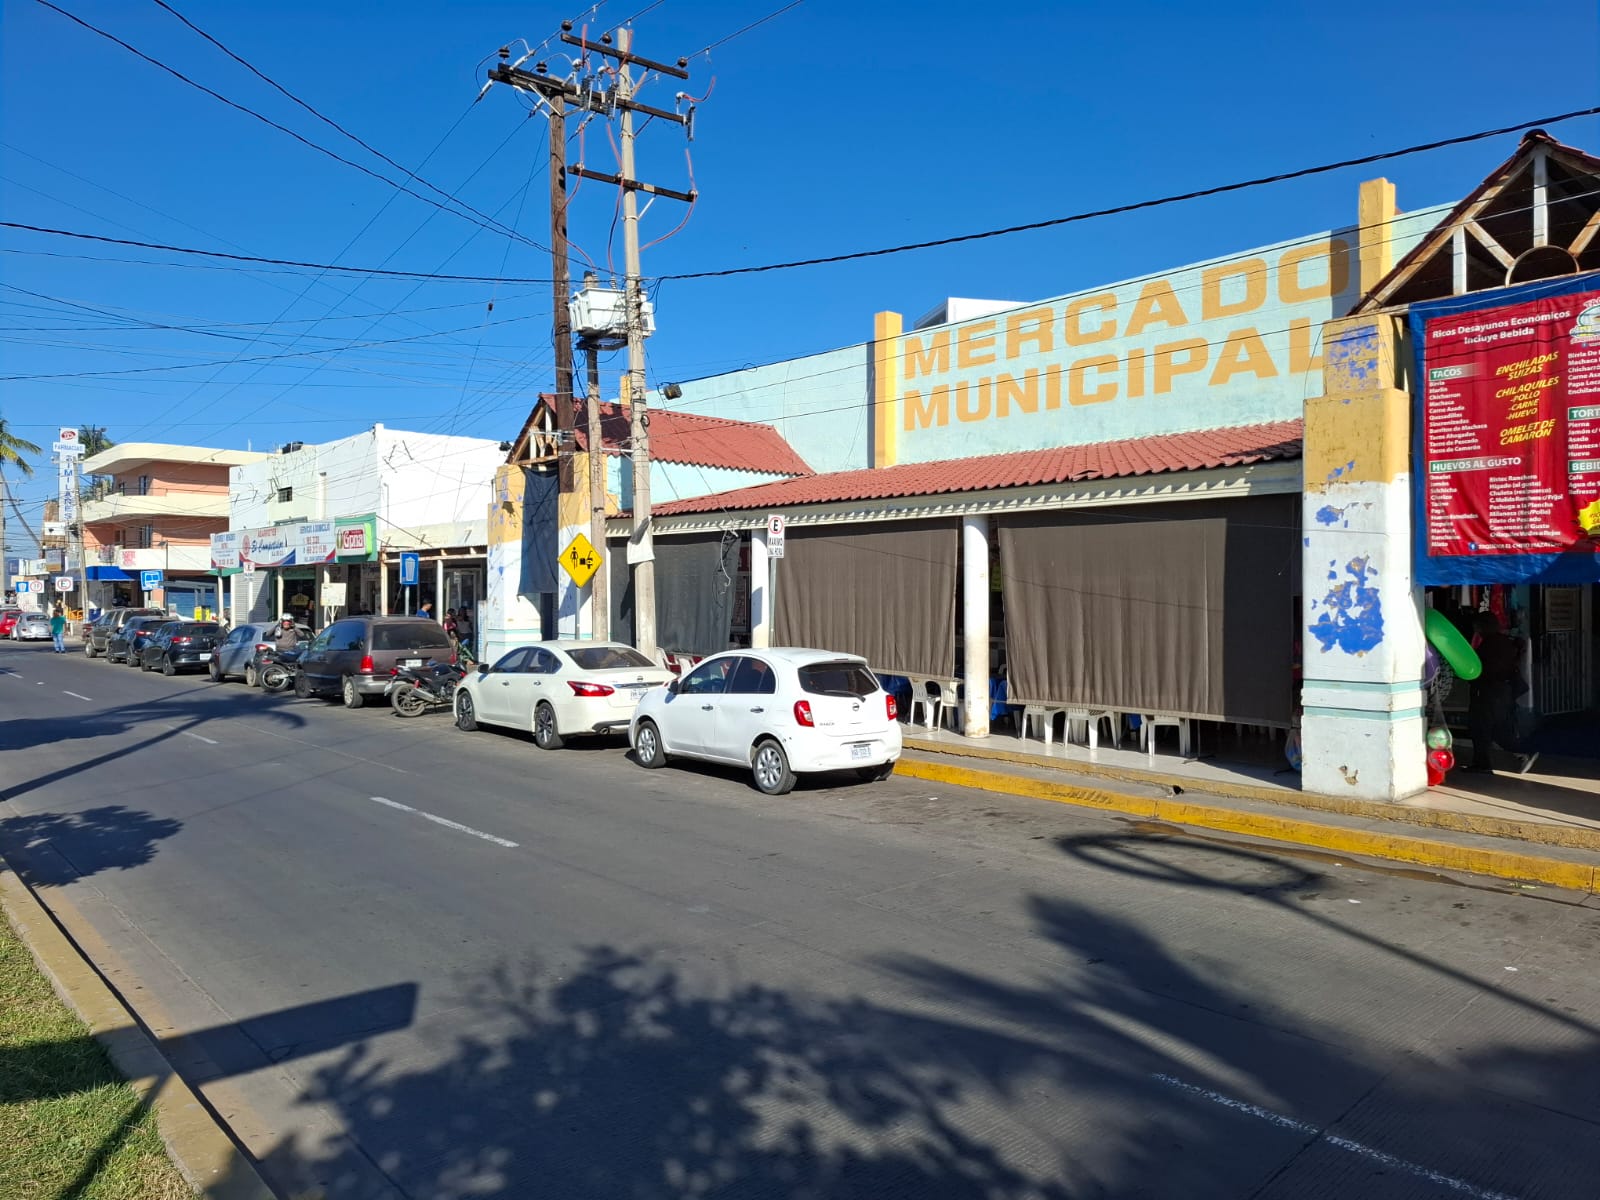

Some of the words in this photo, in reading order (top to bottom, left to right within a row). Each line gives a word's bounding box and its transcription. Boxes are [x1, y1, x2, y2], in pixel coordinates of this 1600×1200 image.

[904, 238, 1350, 380] MERCADO
[1432, 329, 1456, 338] Ricos
[1458, 320, 1509, 334] Desayunos
[1464, 333, 1498, 344] Incluye
[1500, 327, 1535, 338] Bebida
[1496, 351, 1560, 376] ENCHILADAS
[1508, 364, 1544, 381] SUIZAS
[902, 314, 1327, 432] MUNICIPAL
[1432, 368, 1462, 379] TACOS
[1496, 376, 1560, 398] CHILAQUILES
[1500, 421, 1541, 437] OMELET
[1541, 418, 1556, 429] DE
[1432, 461, 1471, 472] HUEVOS
[1472, 460, 1486, 468] AL
[1488, 457, 1522, 467] GUSTO
[773, 519, 779, 532] E
